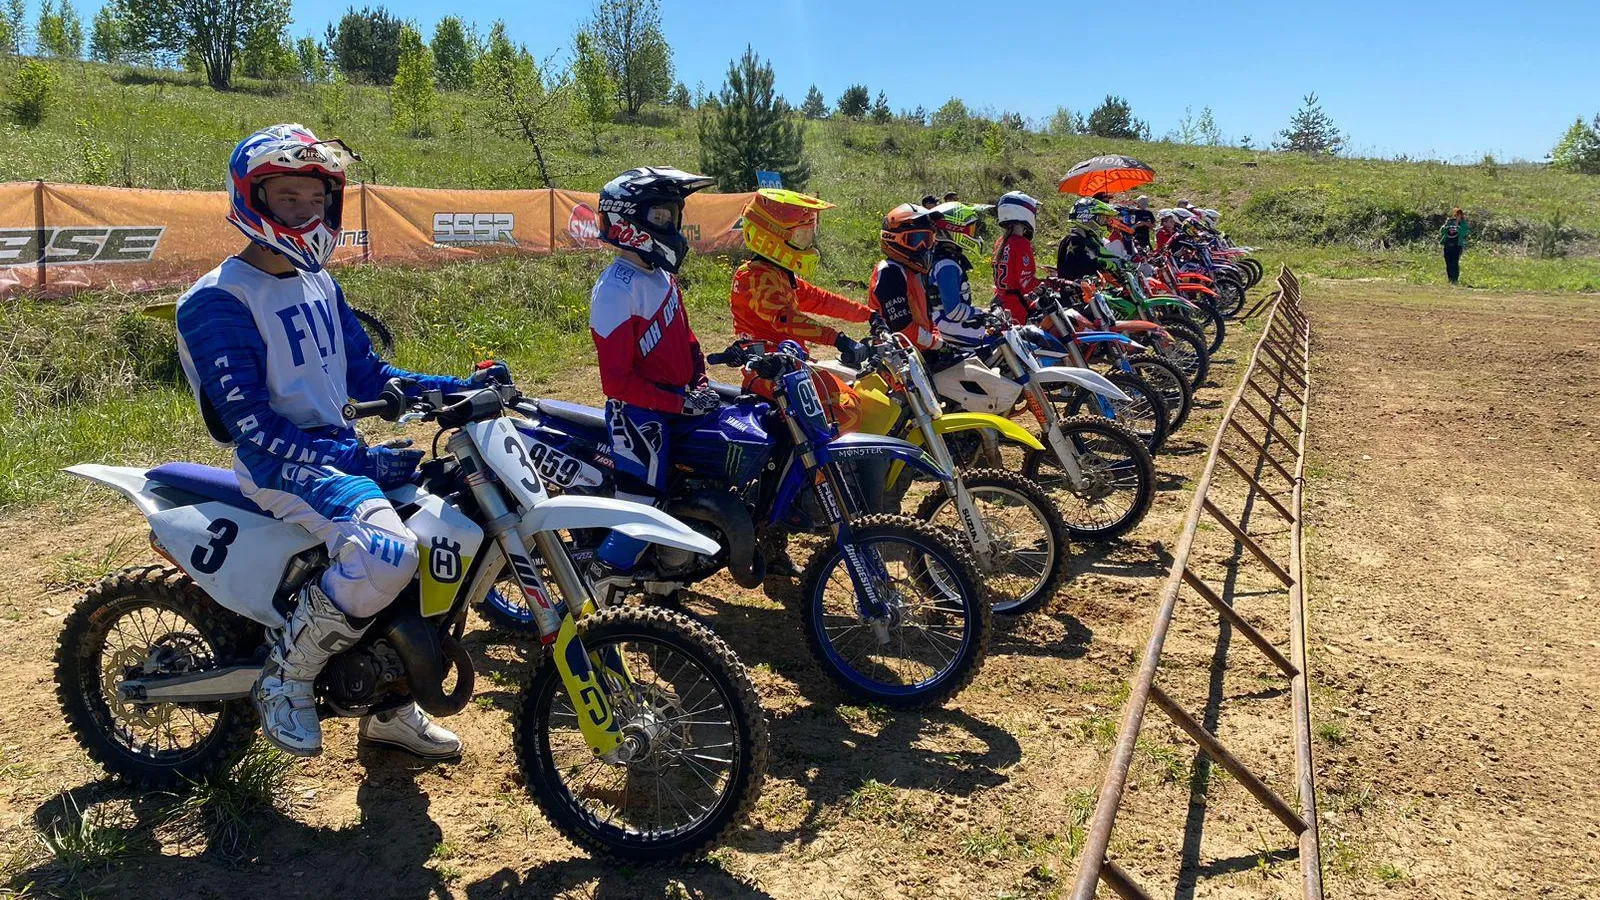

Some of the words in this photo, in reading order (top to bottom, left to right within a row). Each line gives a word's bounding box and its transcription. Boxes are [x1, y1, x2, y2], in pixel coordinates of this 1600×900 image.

[600, 199, 637, 215] 100%
[433, 212, 519, 247] SSSR
[275, 299, 337, 367] FLY
[725, 415, 748, 432] YAMAHA
[503, 436, 541, 493] 3
[529, 442, 581, 486] 959
[838, 447, 883, 458] MONSTER
[190, 518, 239, 574] 3
[369, 533, 405, 568] FLY
[843, 543, 880, 605] BRIDGESTONE
